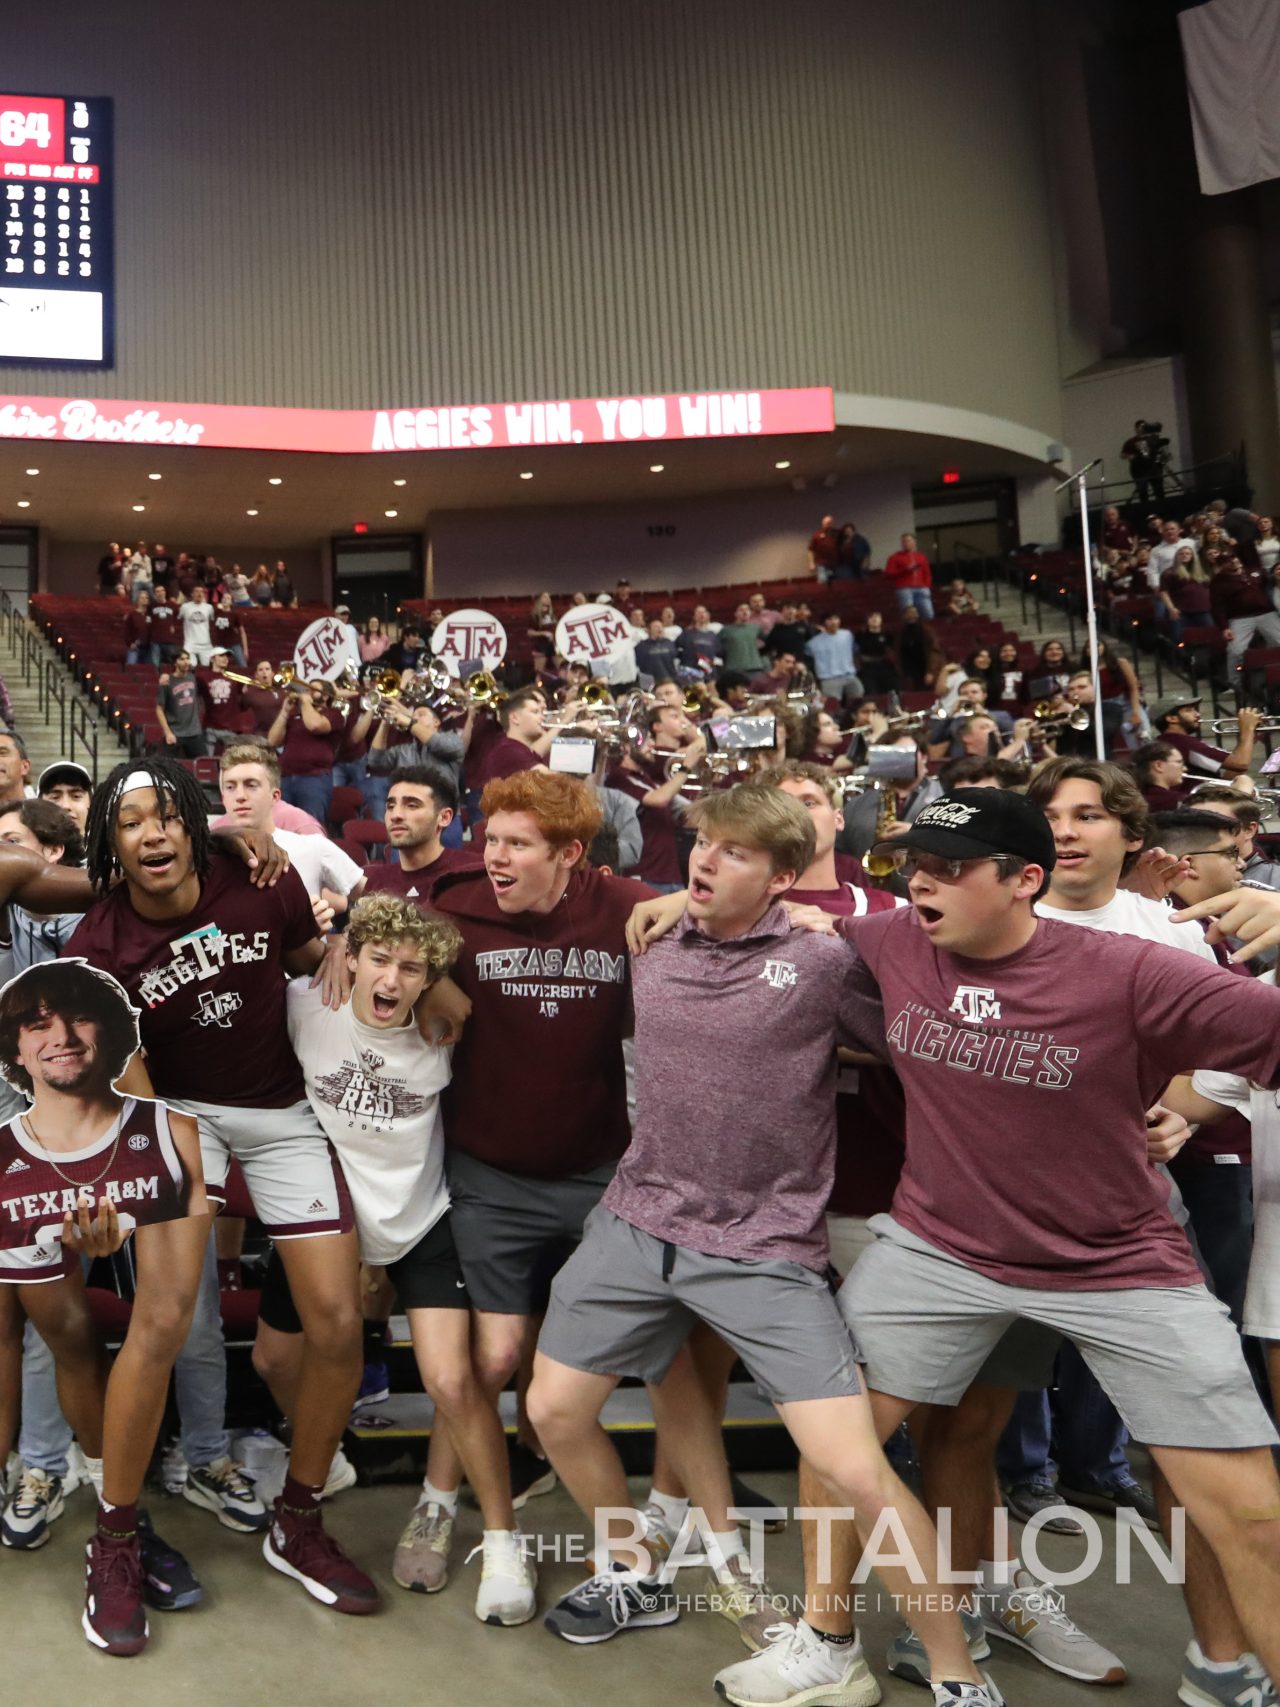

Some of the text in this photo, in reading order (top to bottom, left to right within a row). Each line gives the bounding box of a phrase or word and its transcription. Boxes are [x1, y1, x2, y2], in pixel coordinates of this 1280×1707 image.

[0, 111, 50, 147] 64
[60, 400, 204, 444] Brothers
[372, 393, 762, 451] AGGIES WIN, YOU WIN!
[476, 947, 624, 983] TEXAS A&M
[501, 982, 597, 998] UNIVERSITY
[905, 1002, 936, 1018] TEXAS
[886, 1009, 1080, 1090] AGGIES
[129, 1136, 149, 1149] SEC
[5, 1164, 31, 1175] adidas
[1, 1176, 158, 1222] TEXAS A&M
